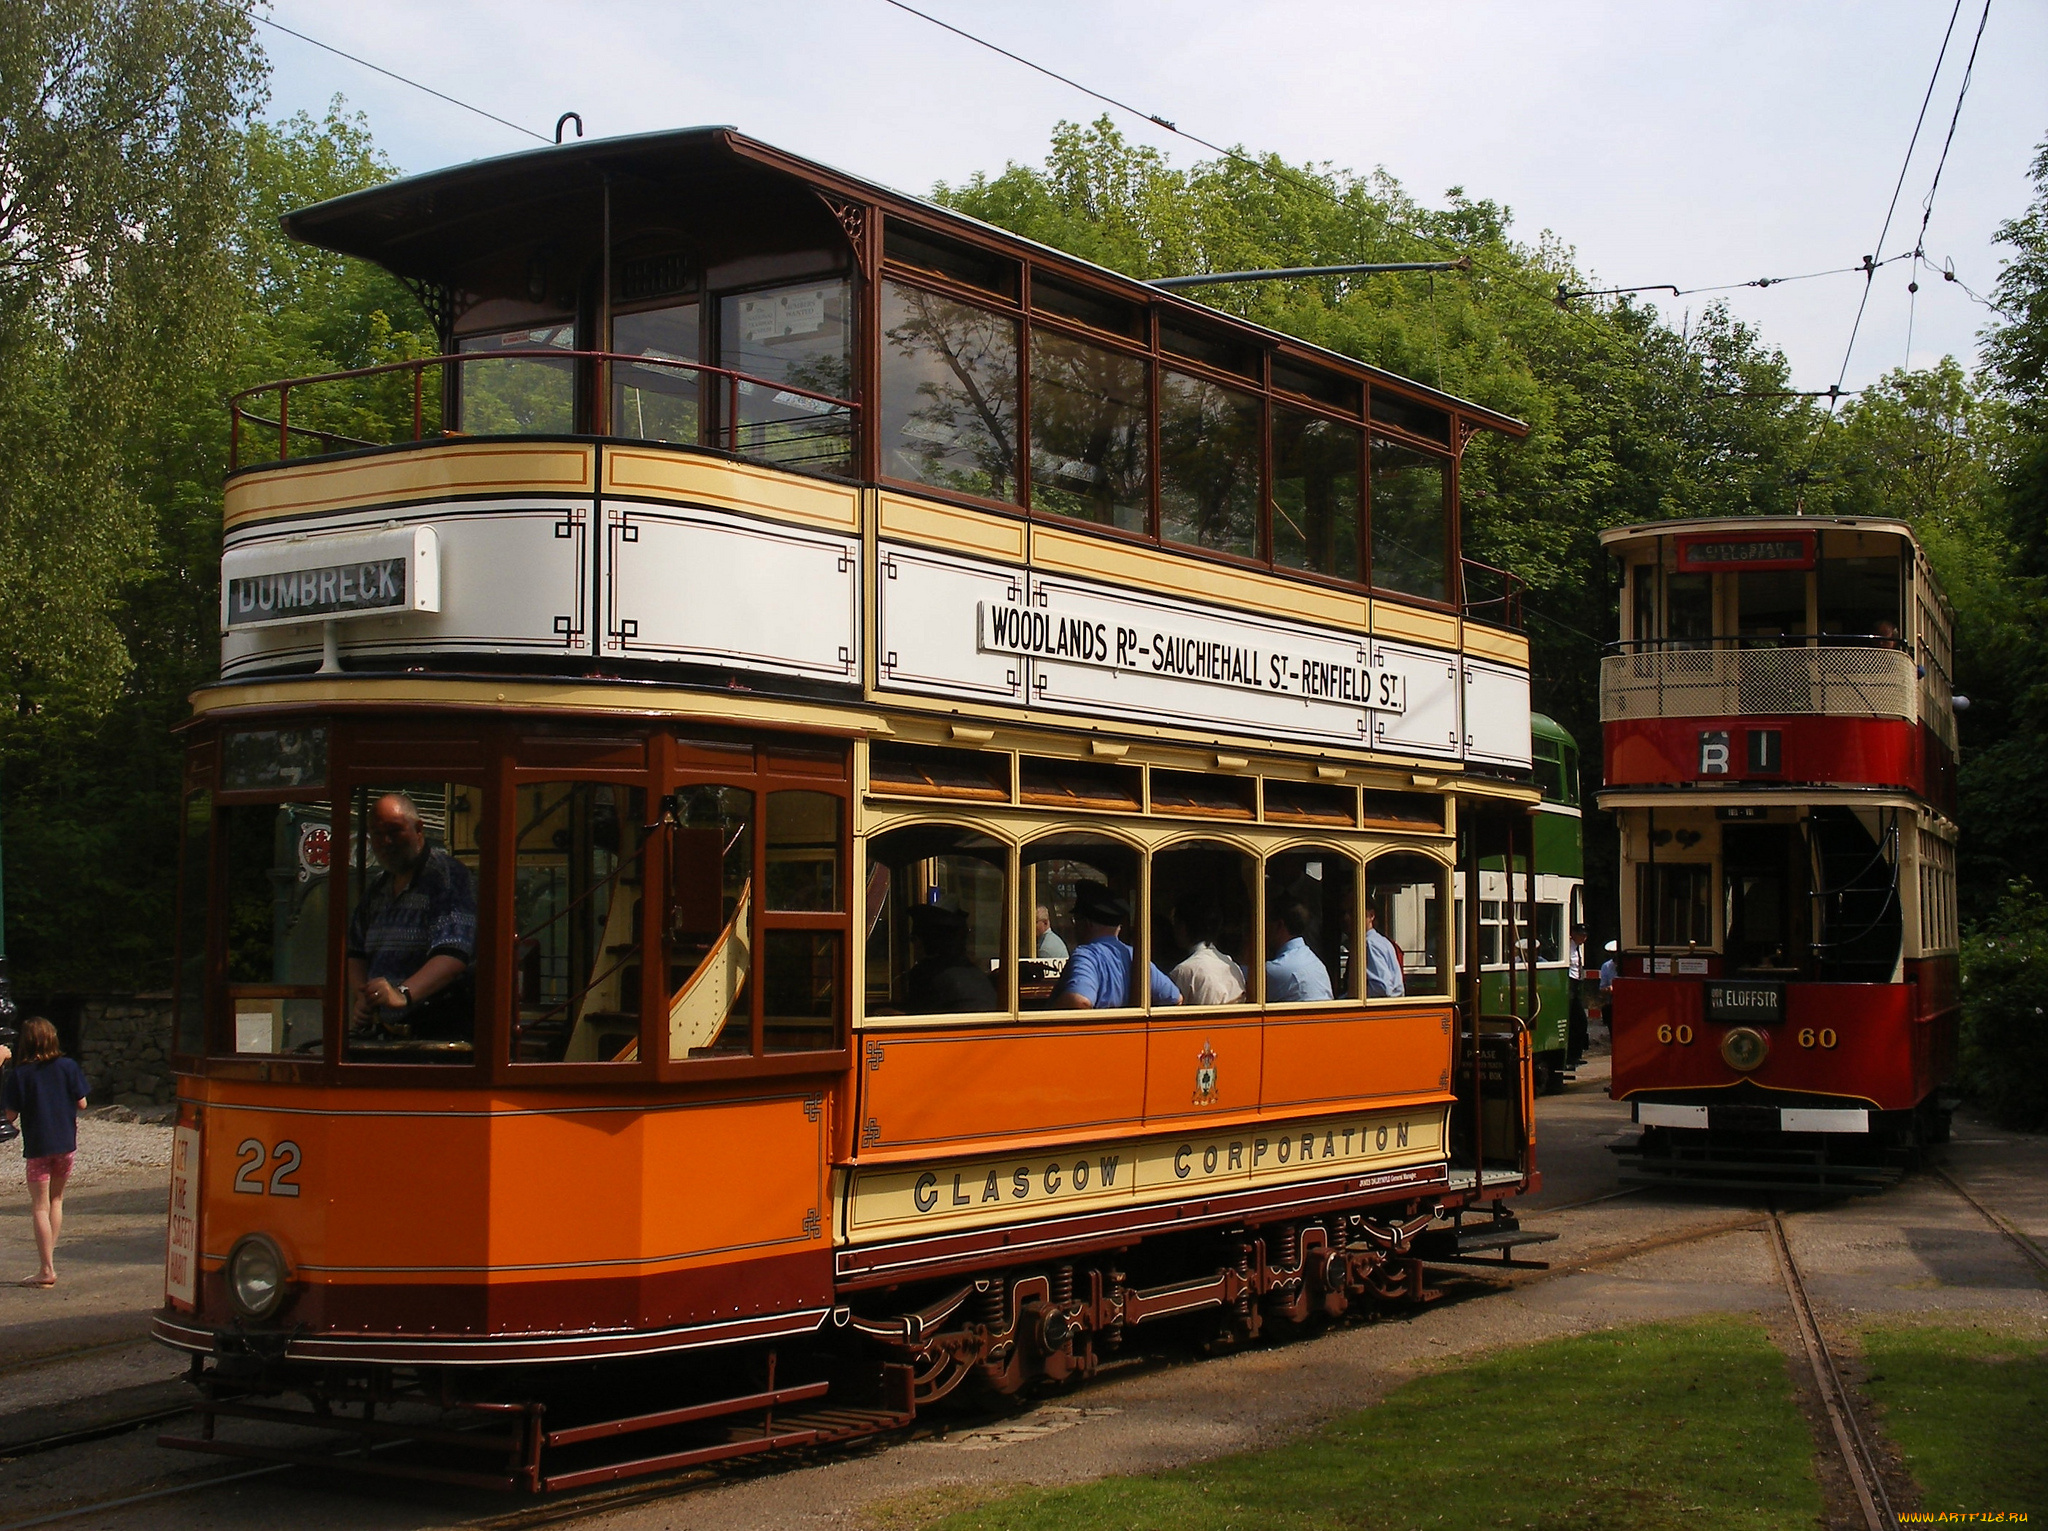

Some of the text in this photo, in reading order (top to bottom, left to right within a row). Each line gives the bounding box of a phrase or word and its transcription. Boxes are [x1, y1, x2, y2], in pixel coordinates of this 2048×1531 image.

[1705, 544, 1735, 555] CITY
[238, 559, 398, 614] DUMBRECK
[992, 605, 1108, 663] WOODLANDS
[1726, 989, 1778, 1008] ELOFFSTR
[1657, 1024, 1693, 1044] 60
[1798, 1027, 1837, 1048] 60
[234, 1138, 302, 1197] 22
[913, 1121, 1410, 1213] GLASGOW CORPORATION
